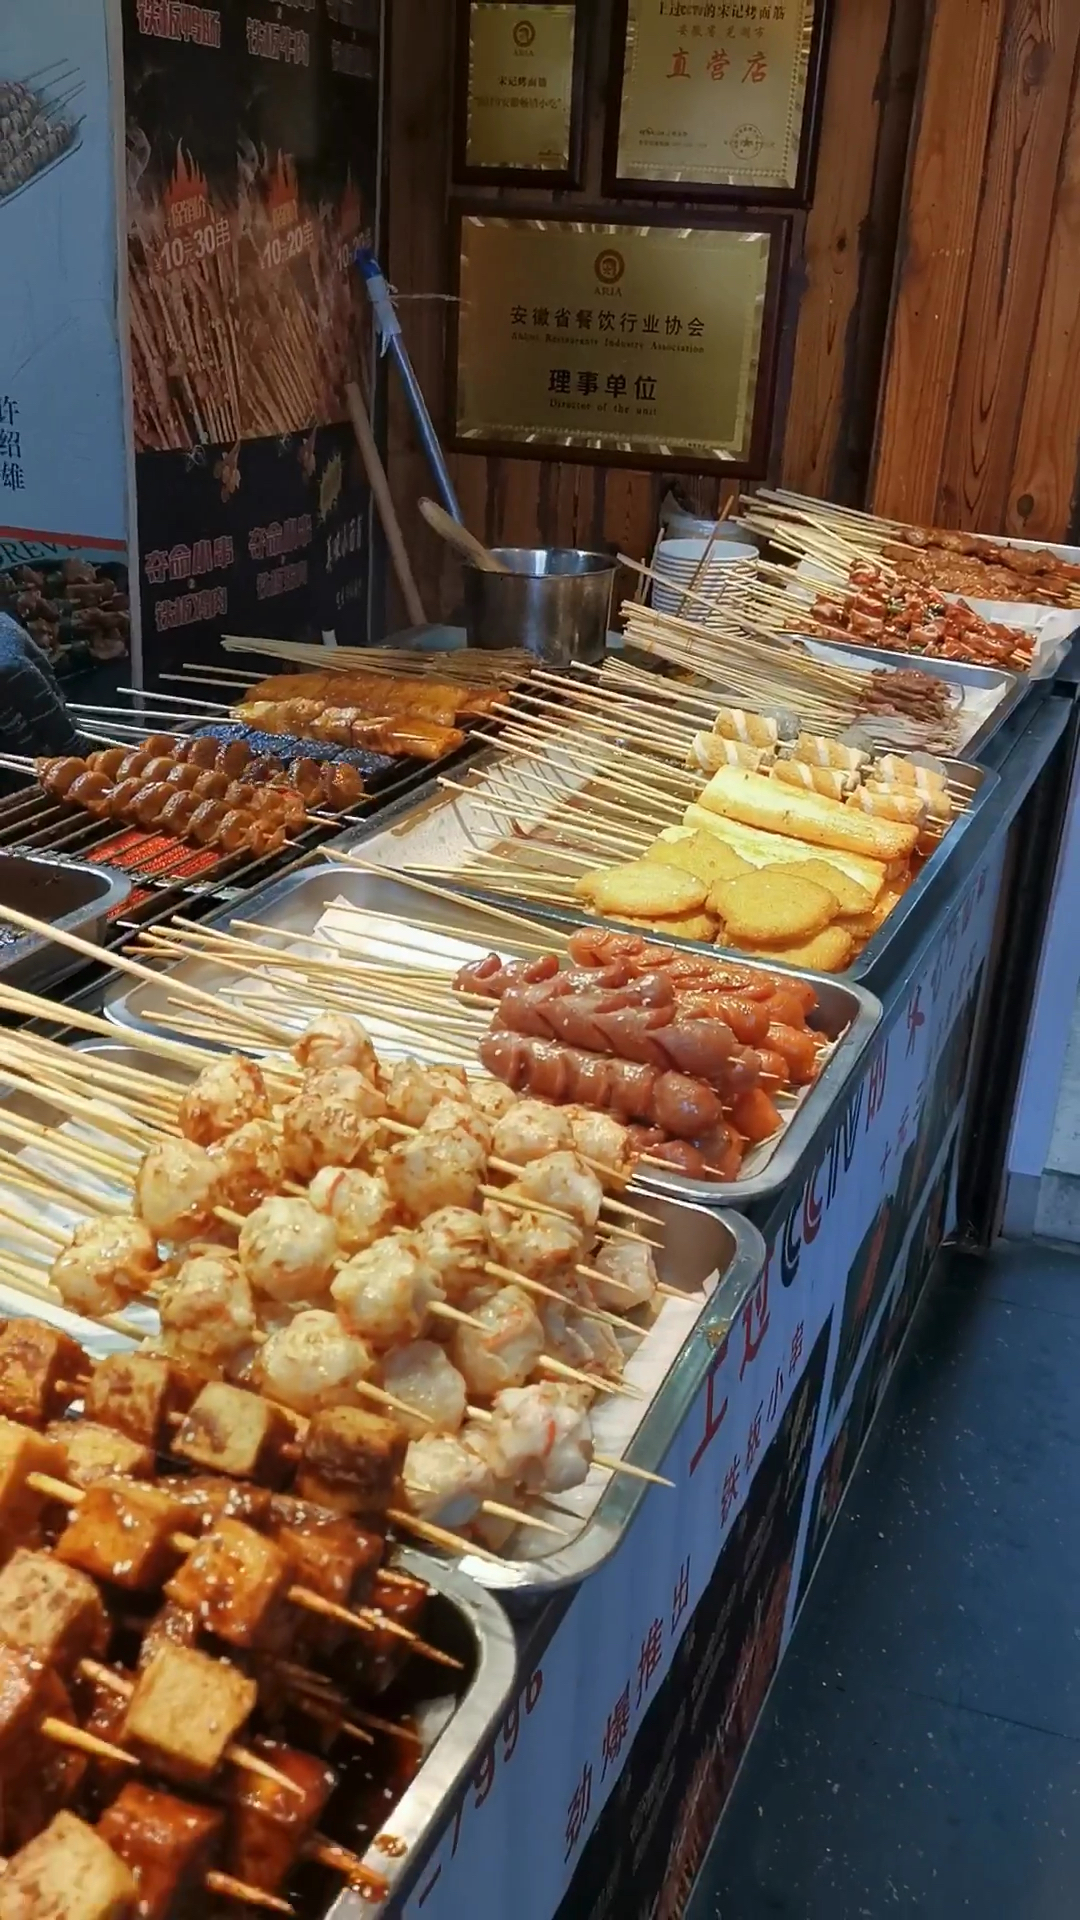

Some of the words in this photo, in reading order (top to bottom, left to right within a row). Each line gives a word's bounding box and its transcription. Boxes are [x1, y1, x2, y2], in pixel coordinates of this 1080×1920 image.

[666, 46, 768, 84] 直营店
[510, 305, 705, 337] 安徽省餐饮行业协会
[548, 369, 657, 401] 理事单位
[564, 1556, 691, 1864] 劲爆推出
